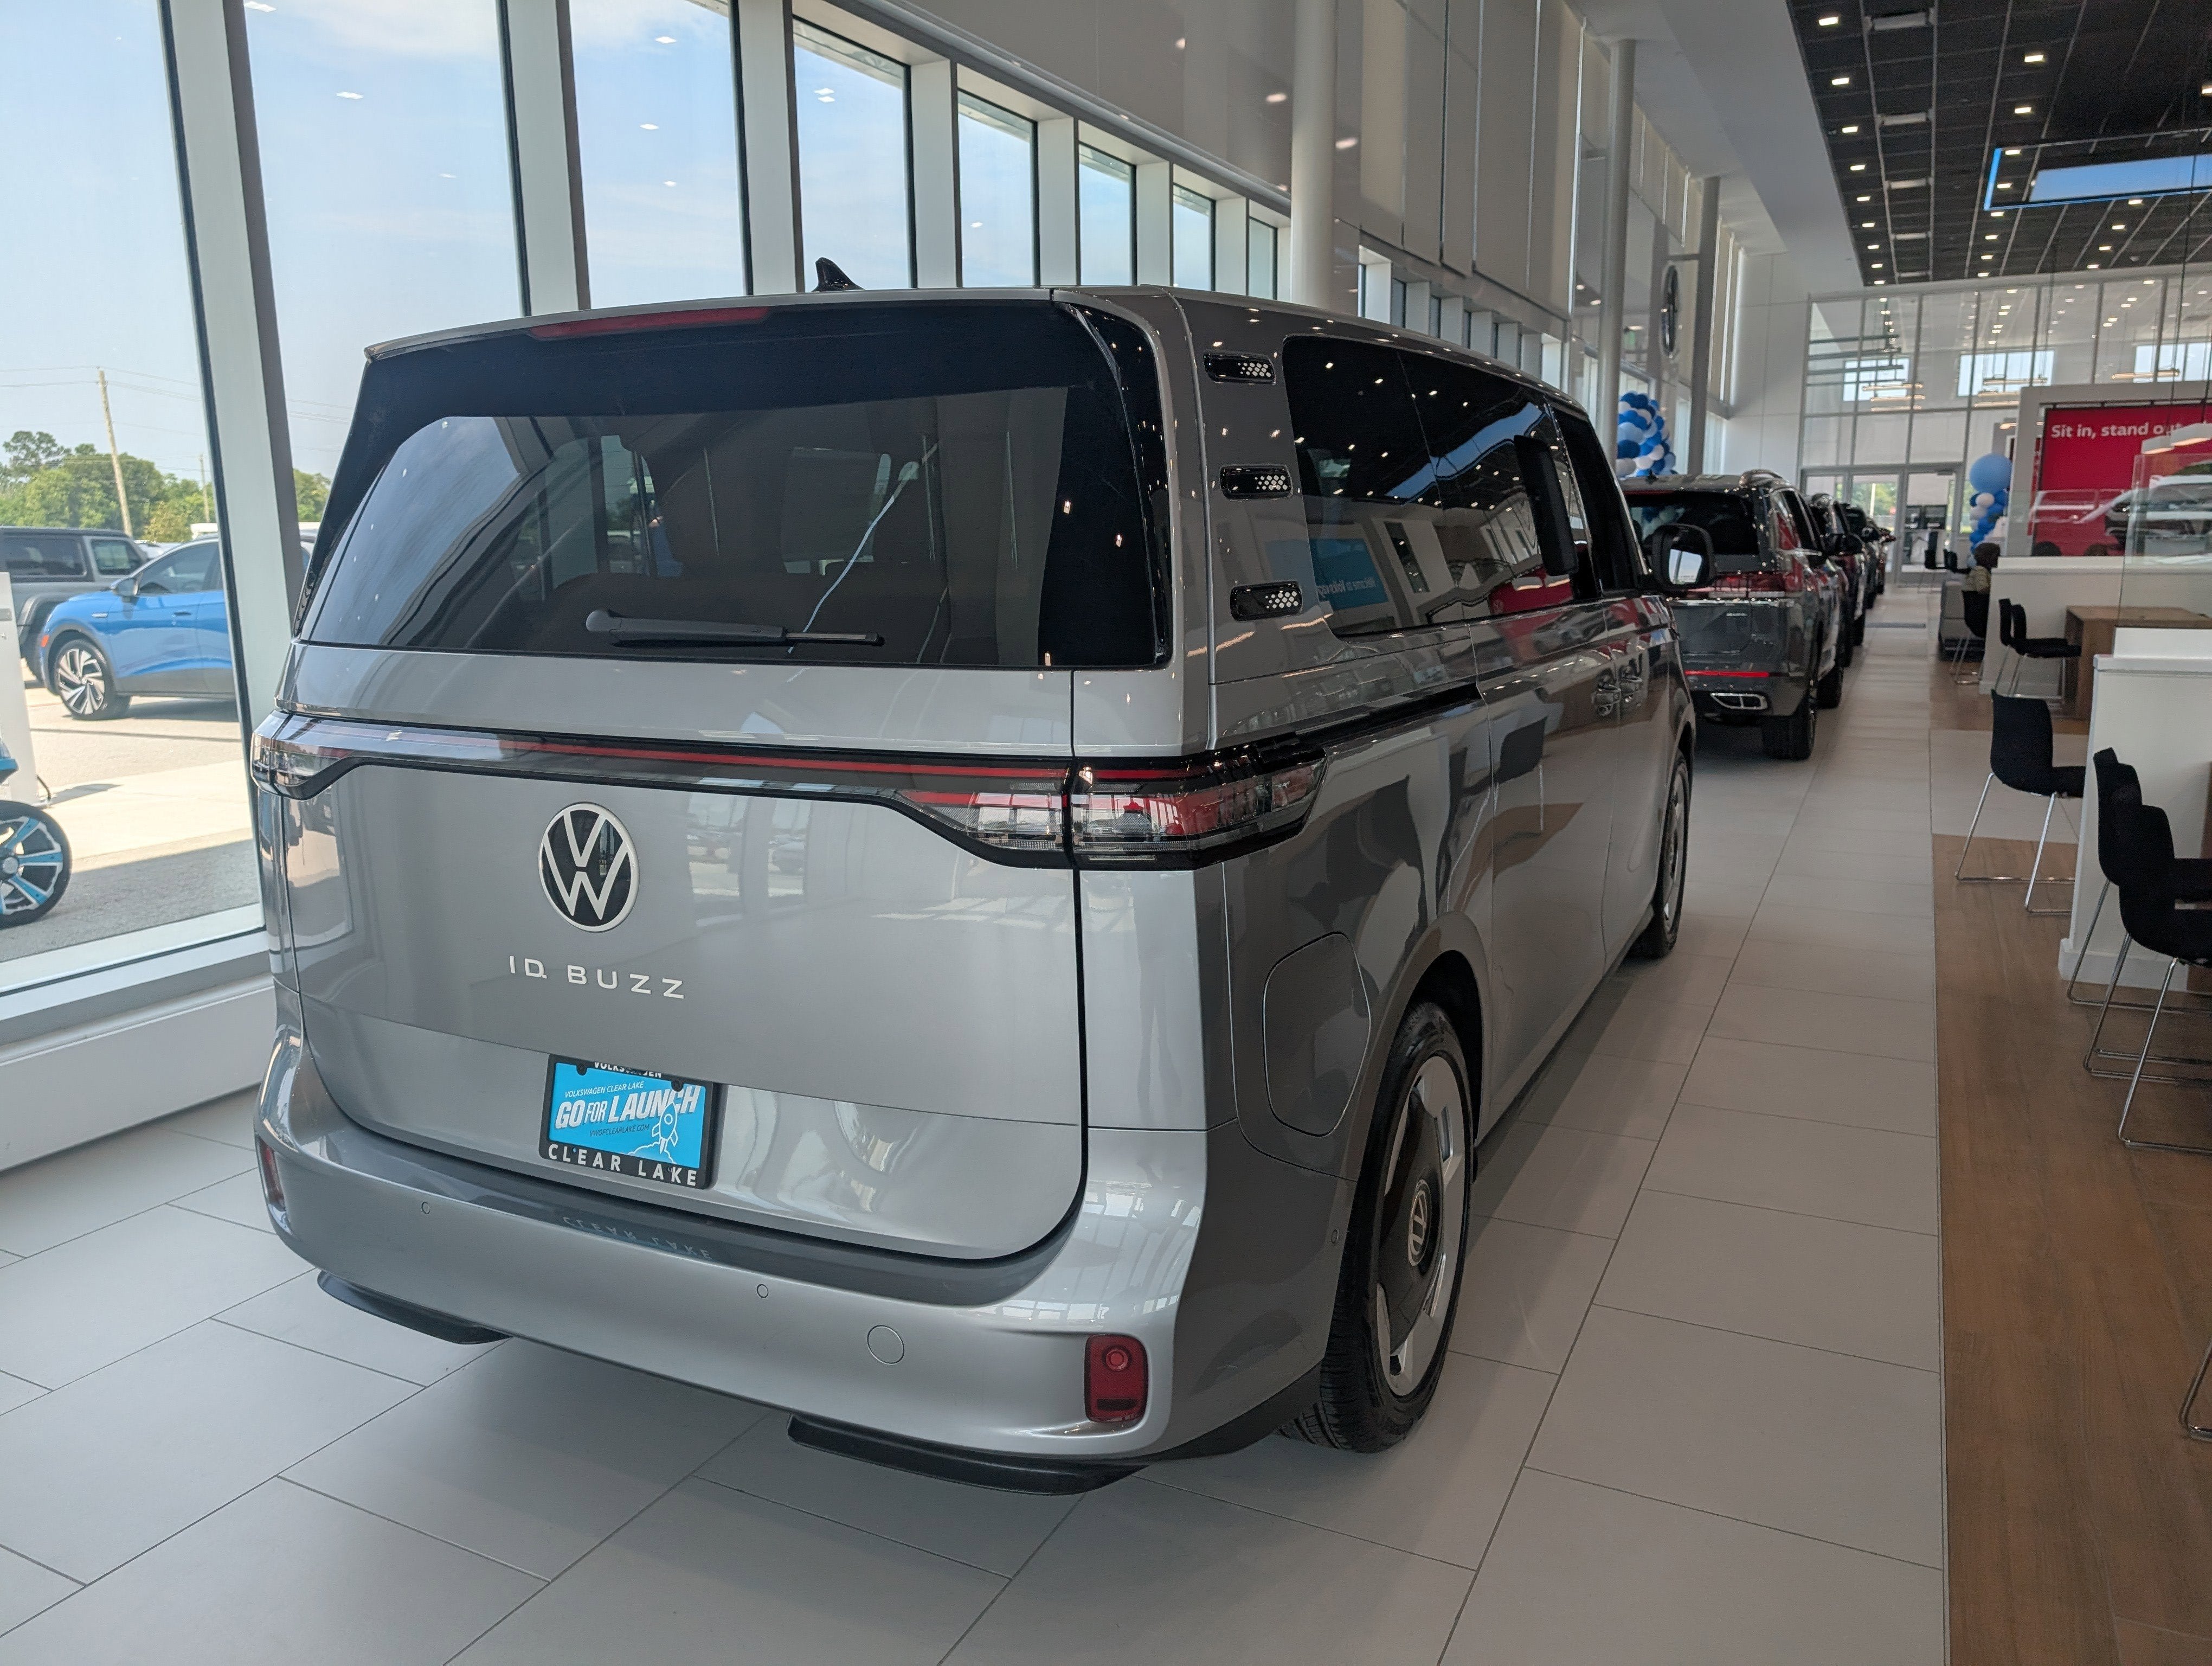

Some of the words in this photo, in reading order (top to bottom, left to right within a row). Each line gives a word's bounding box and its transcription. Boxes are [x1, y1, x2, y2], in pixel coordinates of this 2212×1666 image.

[2051, 424, 2073, 438] Sit
[2076, 424, 2096, 440] in,
[2101, 422, 2149, 437] stand
[567, 964, 684, 999] BUZZ
[565, 1086, 605, 1098] VOLKSWAGEN
[607, 1083, 626, 1093] CLEAR
[628, 1081, 645, 1090] LAKE
[555, 1099, 586, 1130] GO
[584, 1100, 608, 1124] FOR
[607, 1085, 701, 1124] LAUNCH
[589, 1124, 650, 1137] VWOFCLEARLAKE.COM
[548, 1143, 621, 1172] CLEAR
[638, 1159, 698, 1187] LAKE
